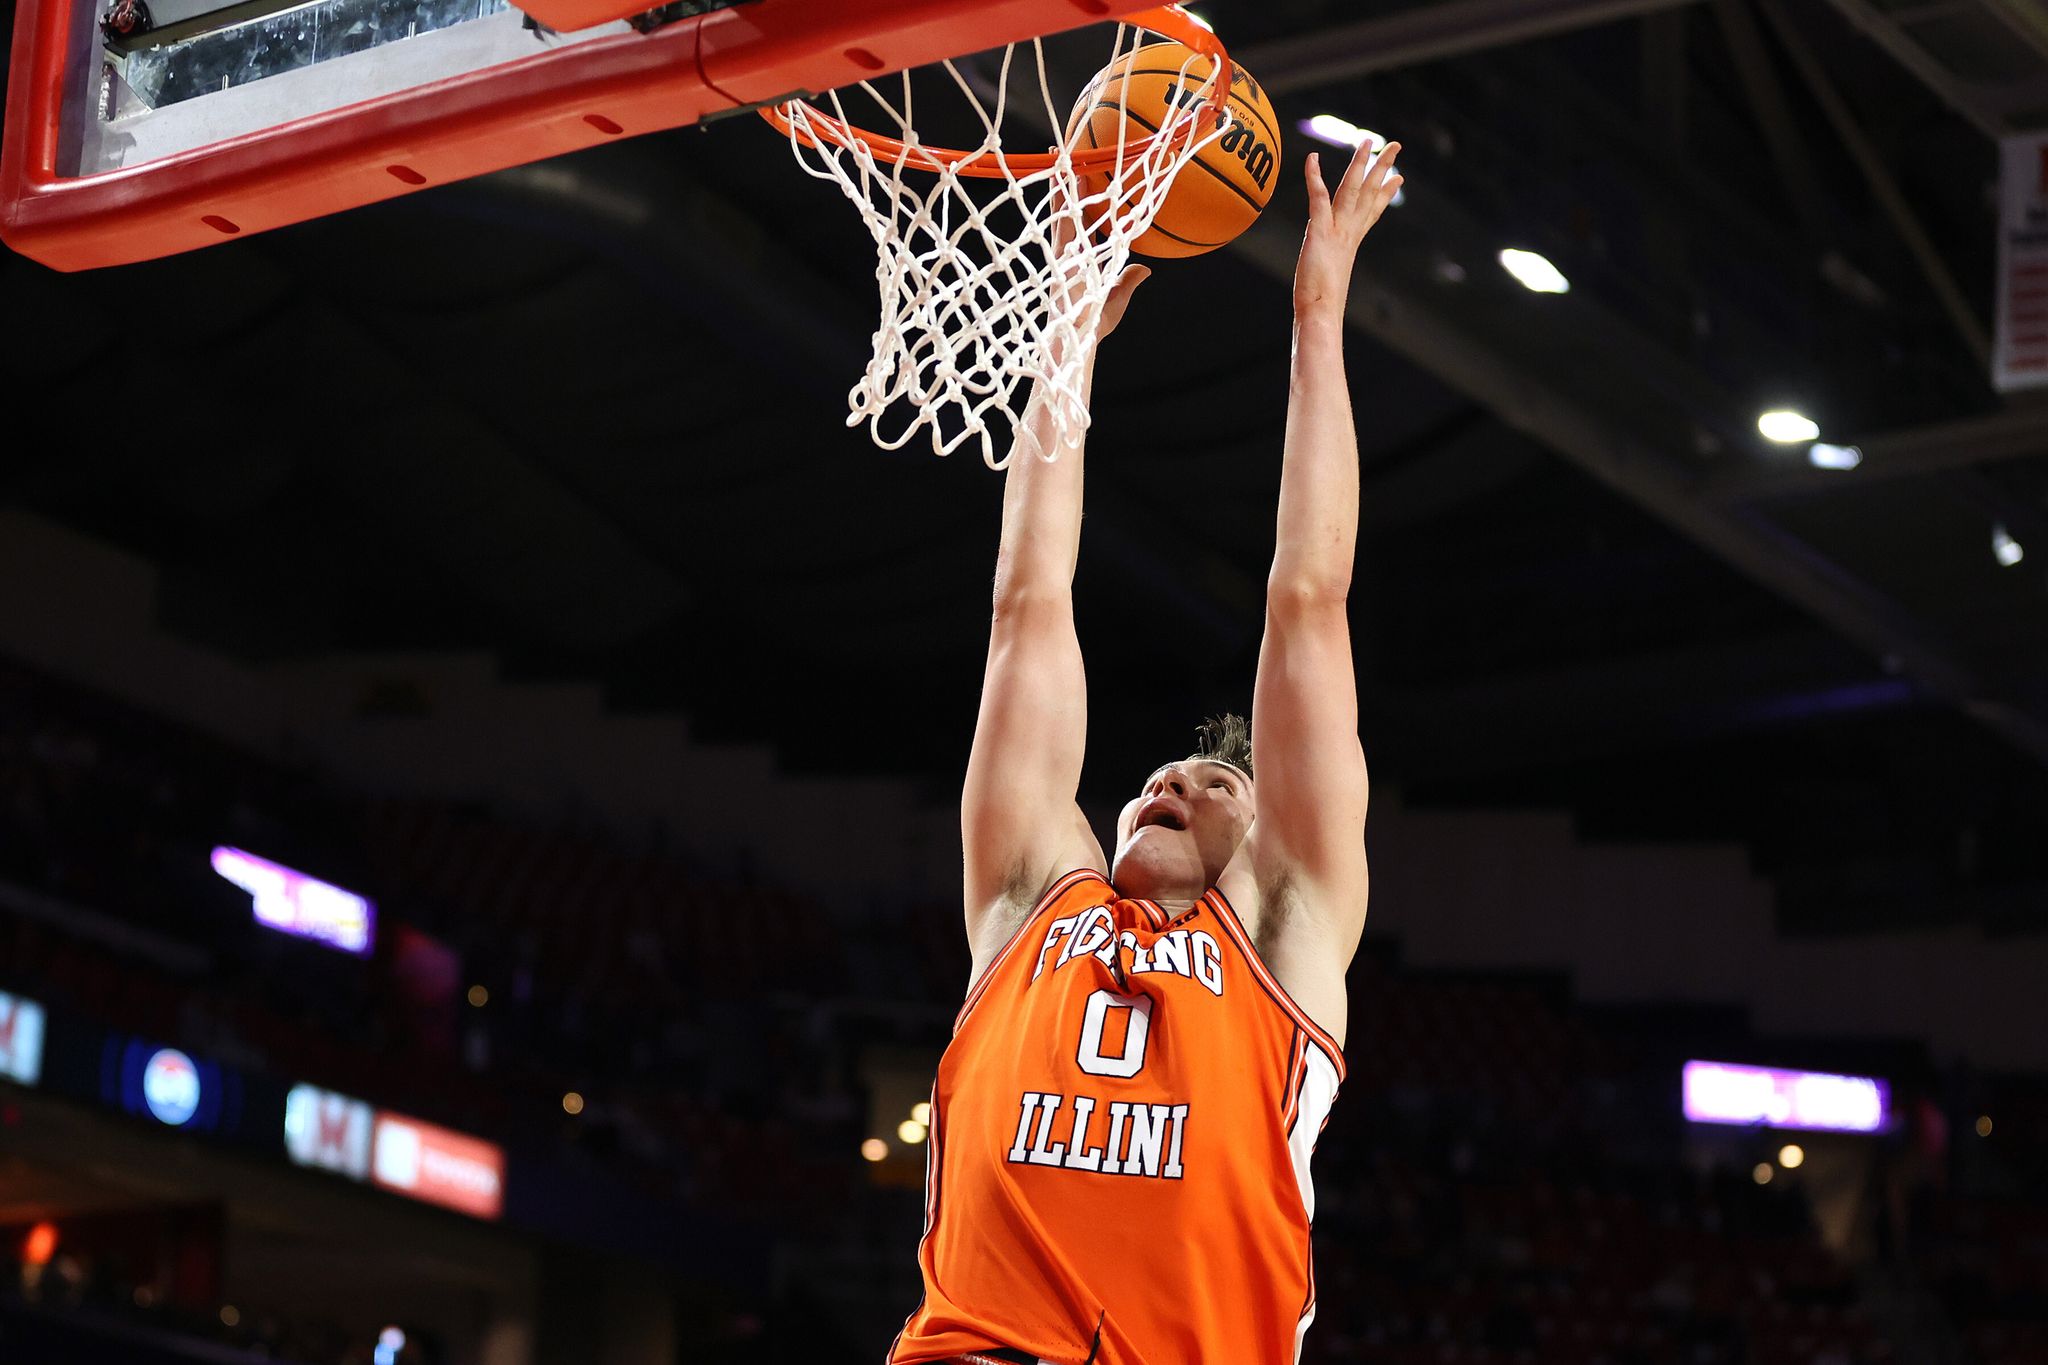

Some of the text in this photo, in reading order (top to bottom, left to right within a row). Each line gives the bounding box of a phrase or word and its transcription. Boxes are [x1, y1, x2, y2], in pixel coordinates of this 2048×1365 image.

[1164, 83, 1274, 192] Wiln
[1075, 989, 1154, 1079] 0
[1007, 1091, 1190, 1180] ILLINI
